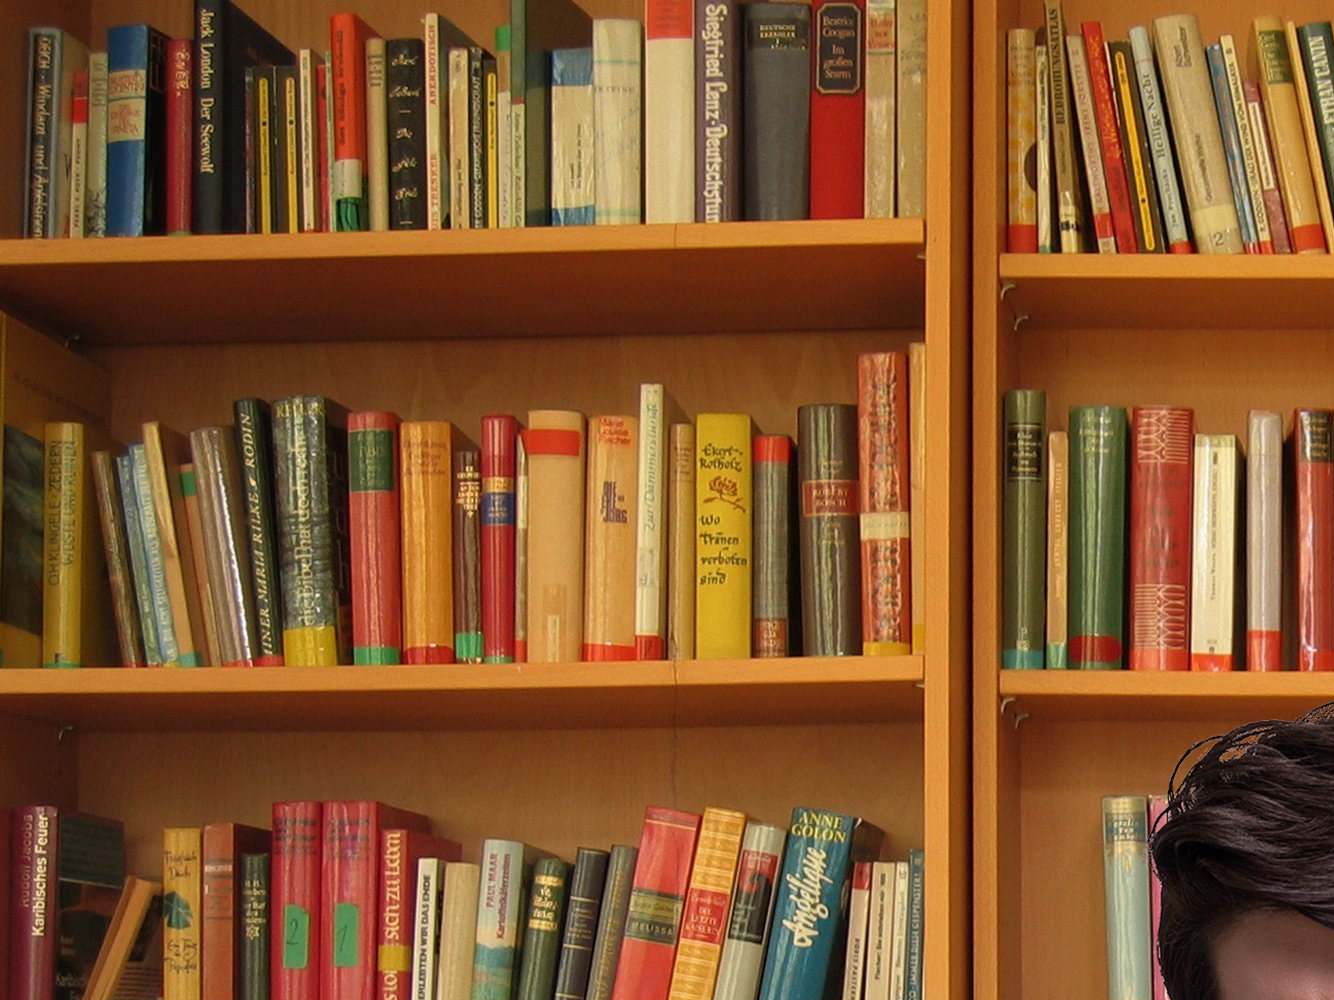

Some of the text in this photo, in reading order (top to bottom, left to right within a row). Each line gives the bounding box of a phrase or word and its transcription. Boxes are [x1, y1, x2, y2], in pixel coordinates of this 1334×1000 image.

[822, 28, 855, 38] Coogan
[823, 17, 854, 26] Beatrice
[702, 4, 727, 77] Siegfried
[832, 45, 845, 55] Im
[1310, 35, 1330, 77] CANIN
[200, 9, 215, 174] Jack London Der Seewolf
[705, 80, 728, 121] Lenz
[699, 515, 720, 525] Wo
[700, 571, 727, 585] sind
[790, 826, 847, 844] GOLON
[798, 811, 844, 831] ANNE
[31, 814, 49, 937] Karibisches Feuer
[421, 874, 432, 902] ENDE
[485, 853, 499, 908] PAUL MAAR
[780, 845, 835, 949] Angélique
[421, 903, 430, 925] DAS
[286, 917, 299, 946] 2
[419, 926, 429, 946] WIR
[417, 948, 428, 1000] ERLEBTEN
